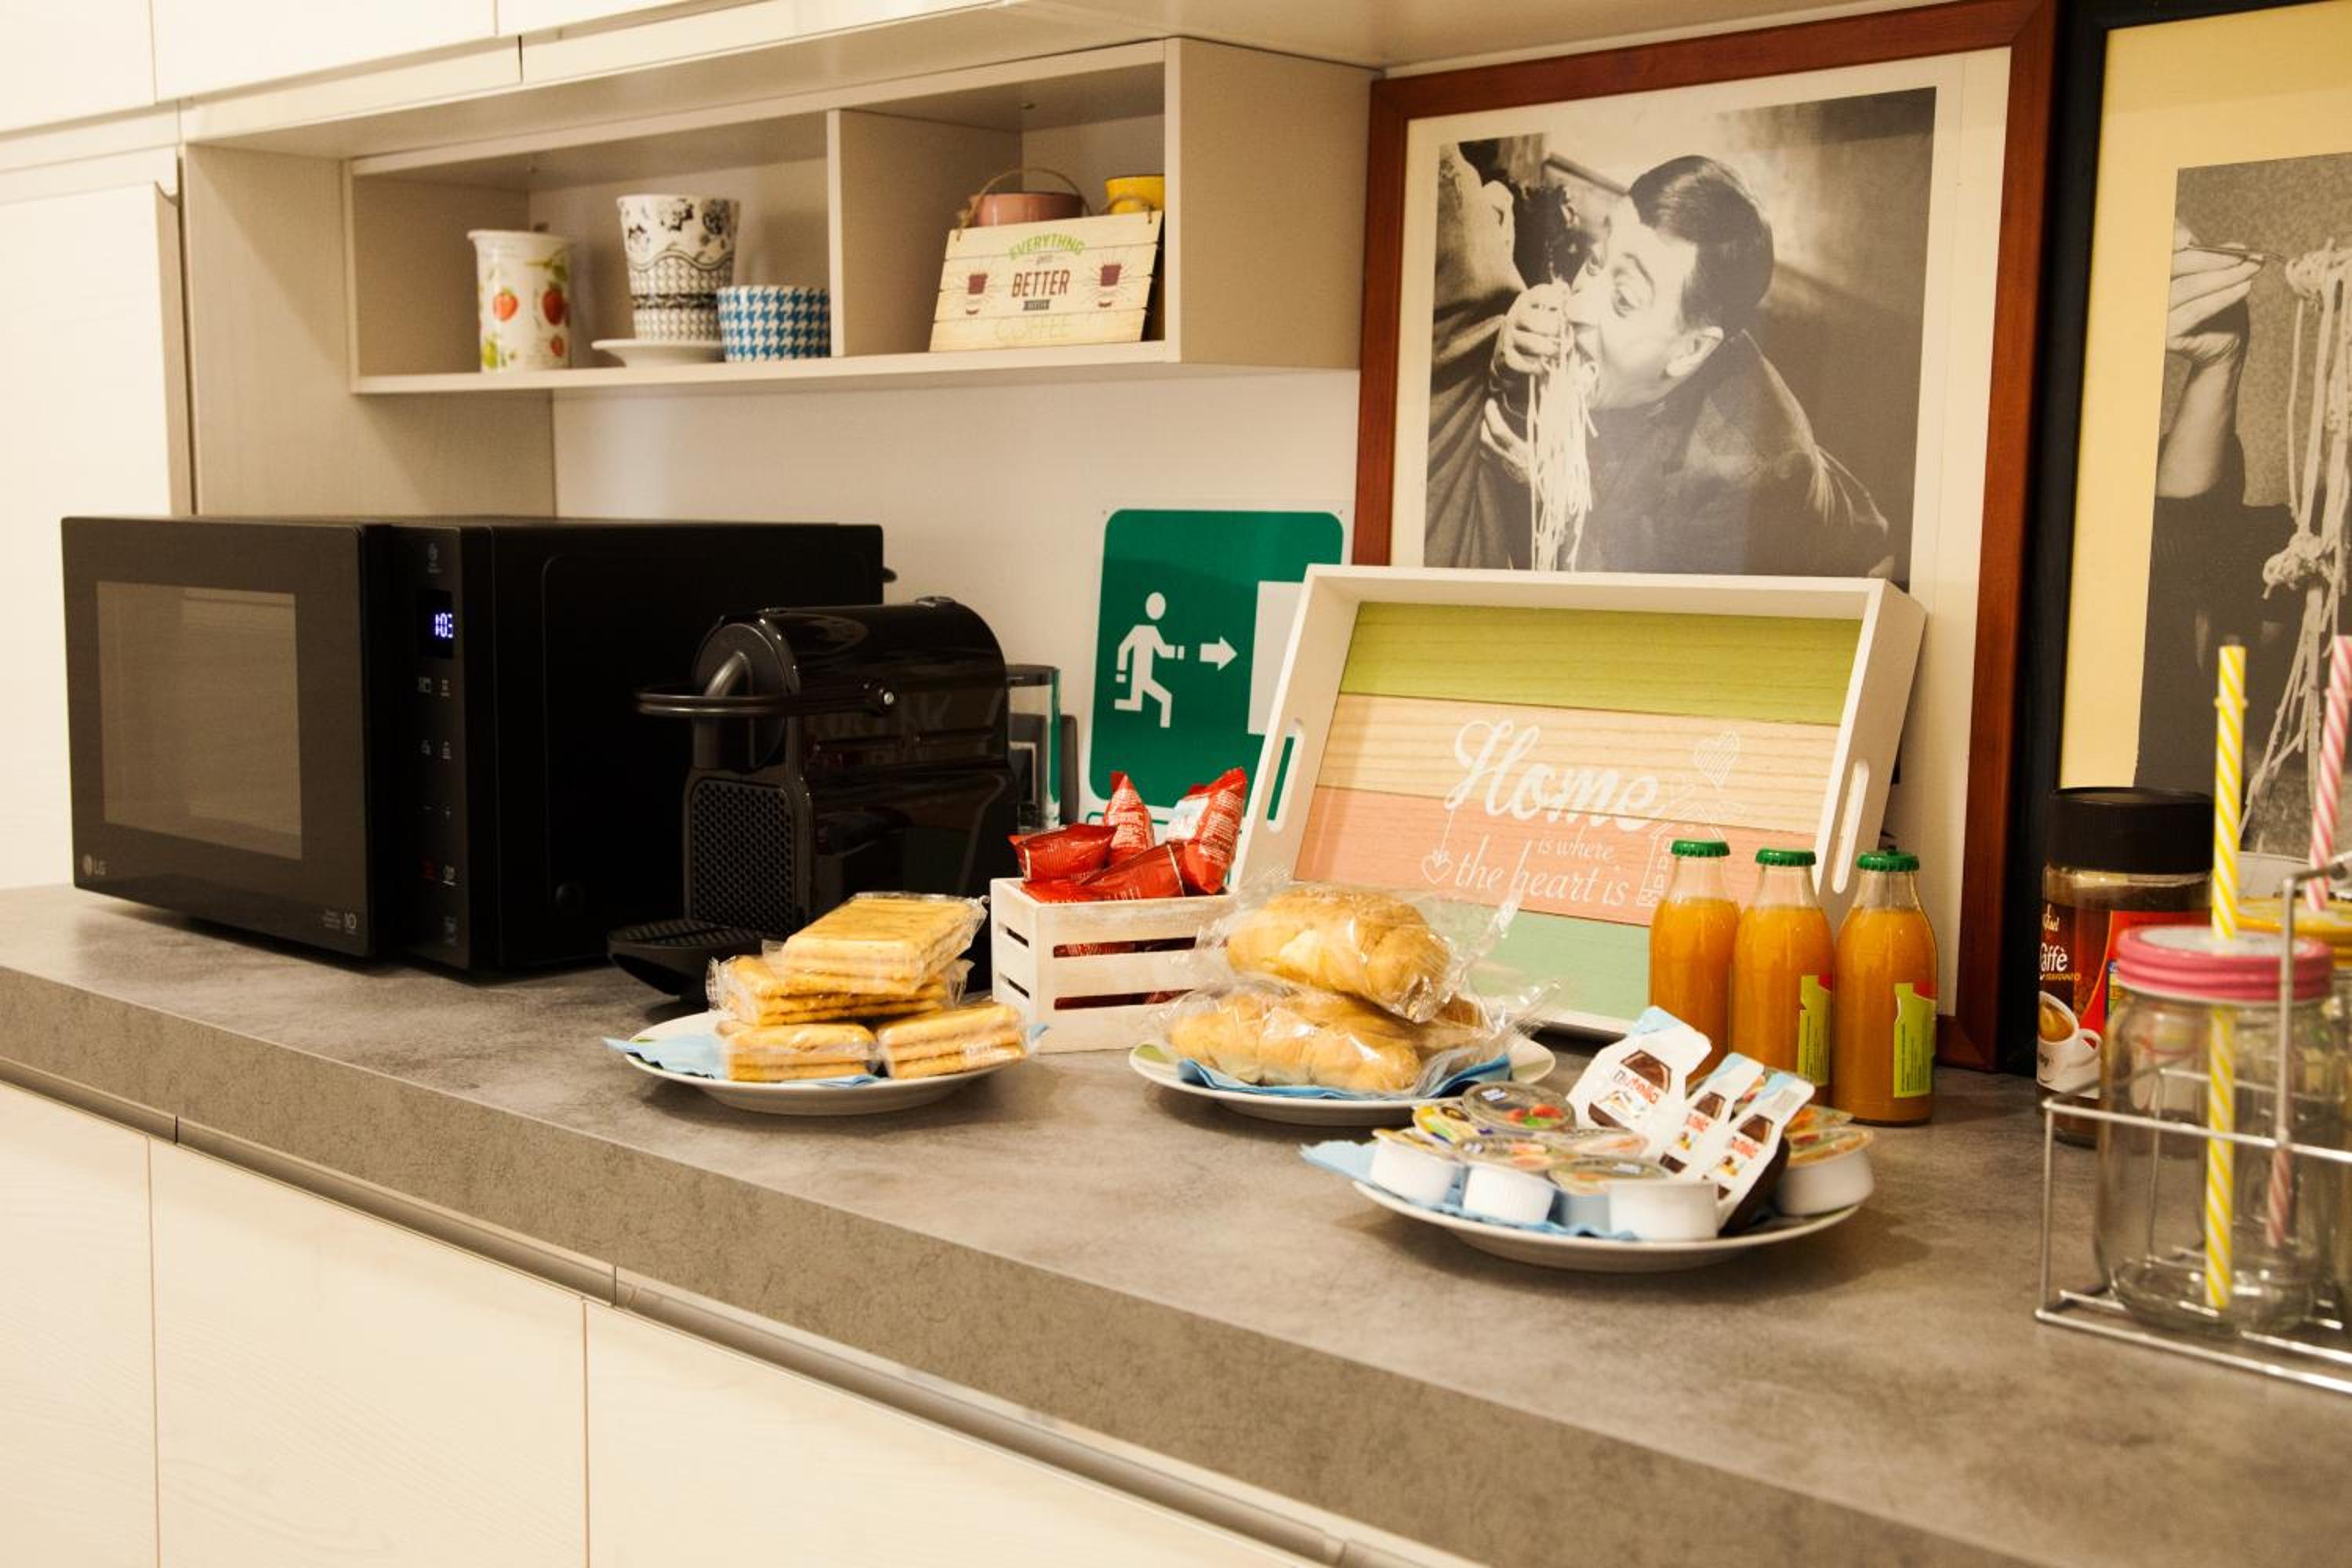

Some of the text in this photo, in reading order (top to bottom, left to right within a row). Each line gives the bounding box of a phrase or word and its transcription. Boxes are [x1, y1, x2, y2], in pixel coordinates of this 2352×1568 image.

[1011, 269, 1070, 298] BETTER
[1444, 720, 1668, 830] Home
[1537, 826, 1614, 861] is where
[94, 859, 107, 877] LG
[1454, 834, 1630, 906] the heart is
